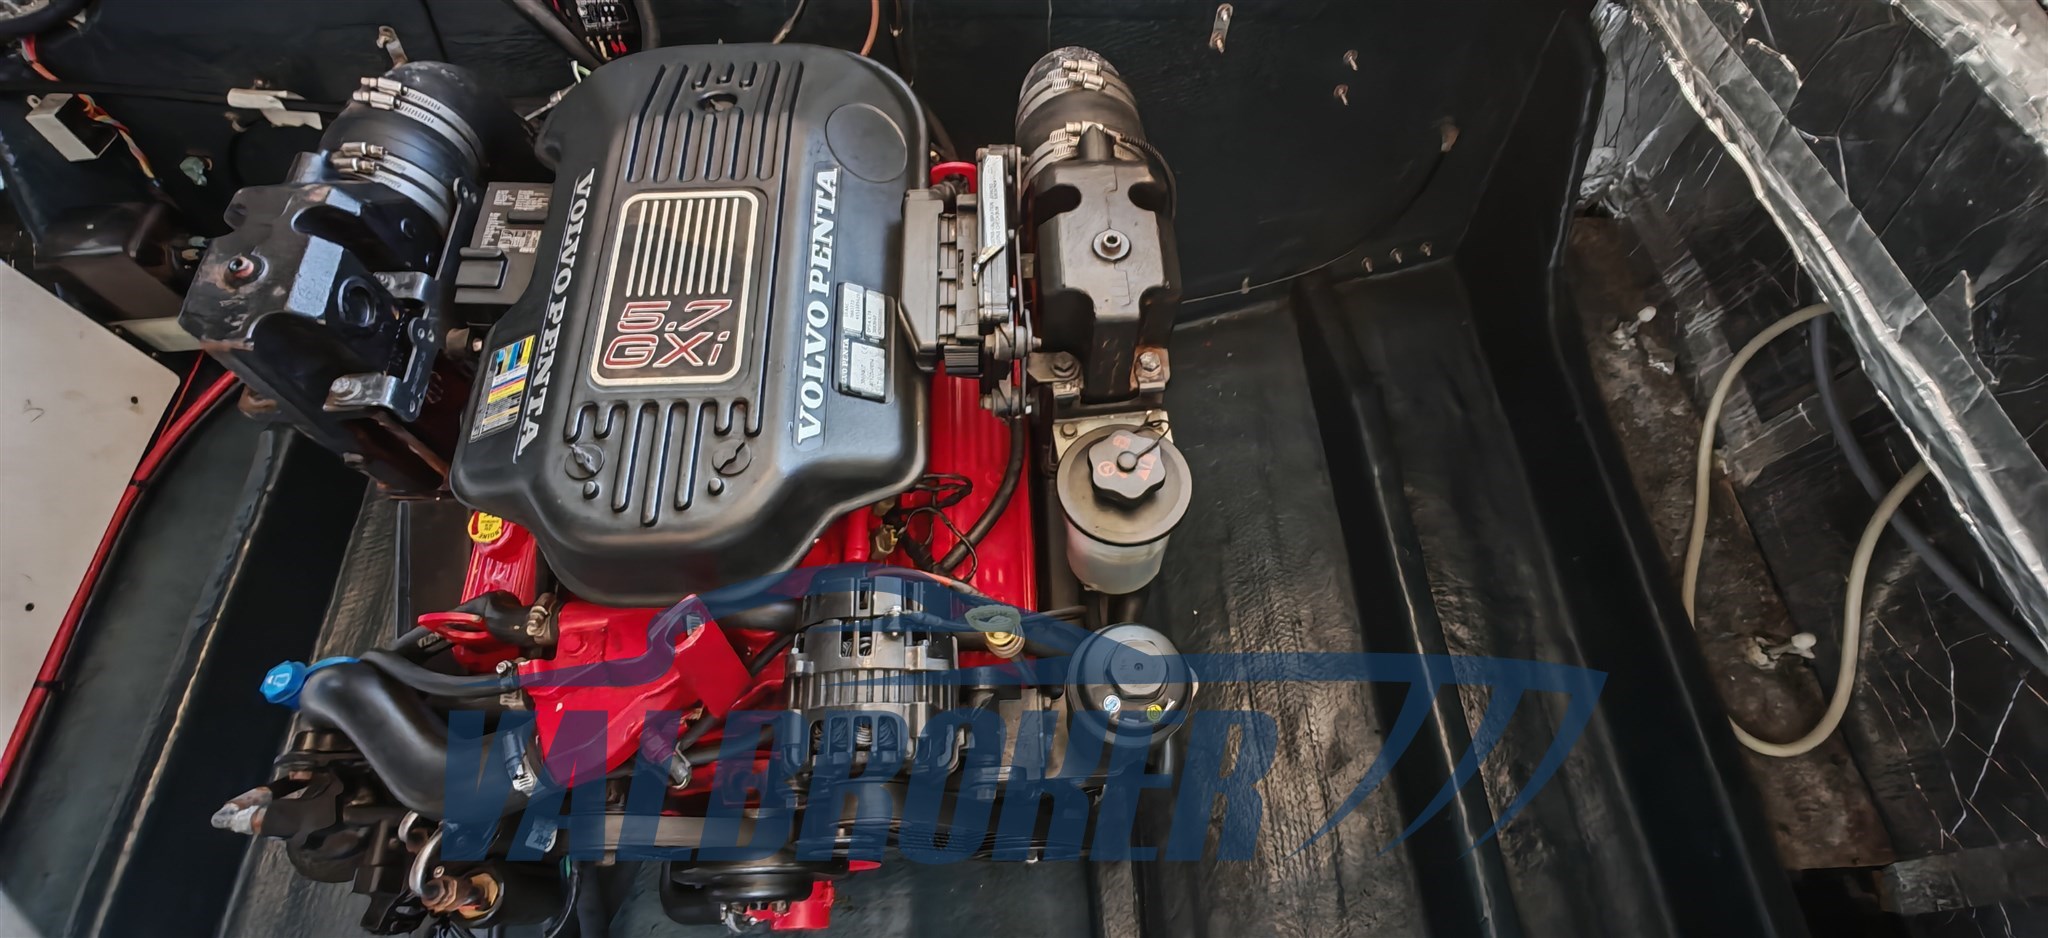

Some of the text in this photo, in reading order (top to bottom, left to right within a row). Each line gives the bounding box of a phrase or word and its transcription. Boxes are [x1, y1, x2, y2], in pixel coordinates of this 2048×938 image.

[554, 168, 595, 295] VOLVO
[602, 330, 731, 370] GXi
[617, 299, 733, 333] 5.7
[797, 167, 838, 443] VOLVO PENTA
[517, 297, 568, 456] PENTA
